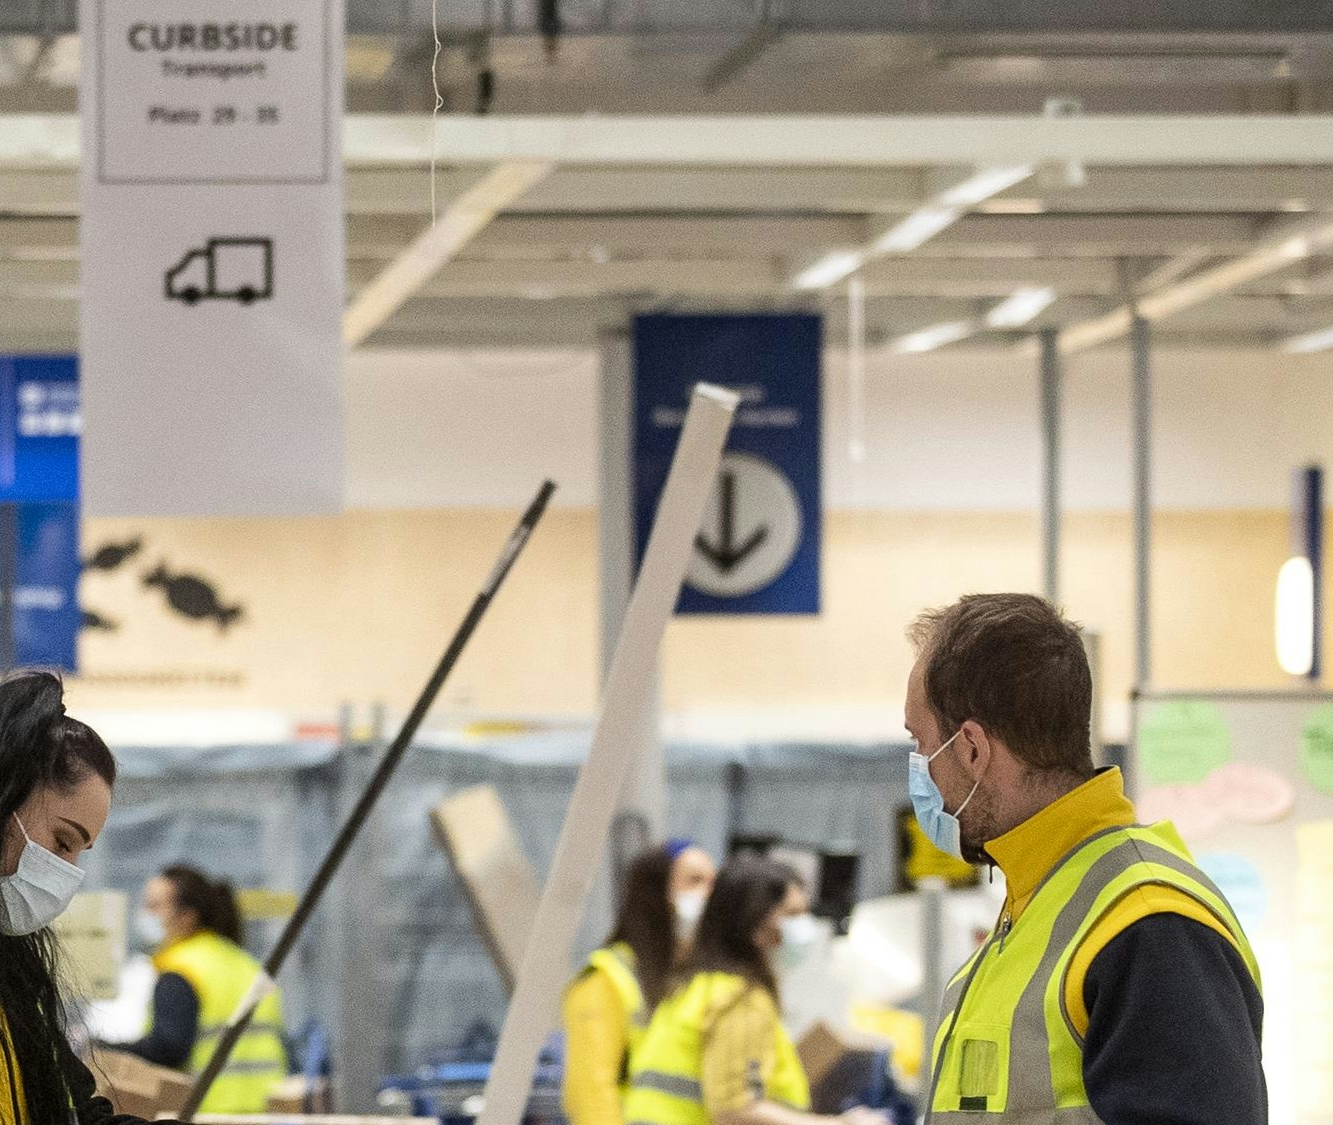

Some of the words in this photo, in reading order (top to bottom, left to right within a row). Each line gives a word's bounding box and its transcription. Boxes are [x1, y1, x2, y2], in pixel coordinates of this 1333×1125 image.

[127, 21, 298, 51] CURBSIDE
[162, 60, 266, 81] Transport
[147, 106, 202, 126] Platz
